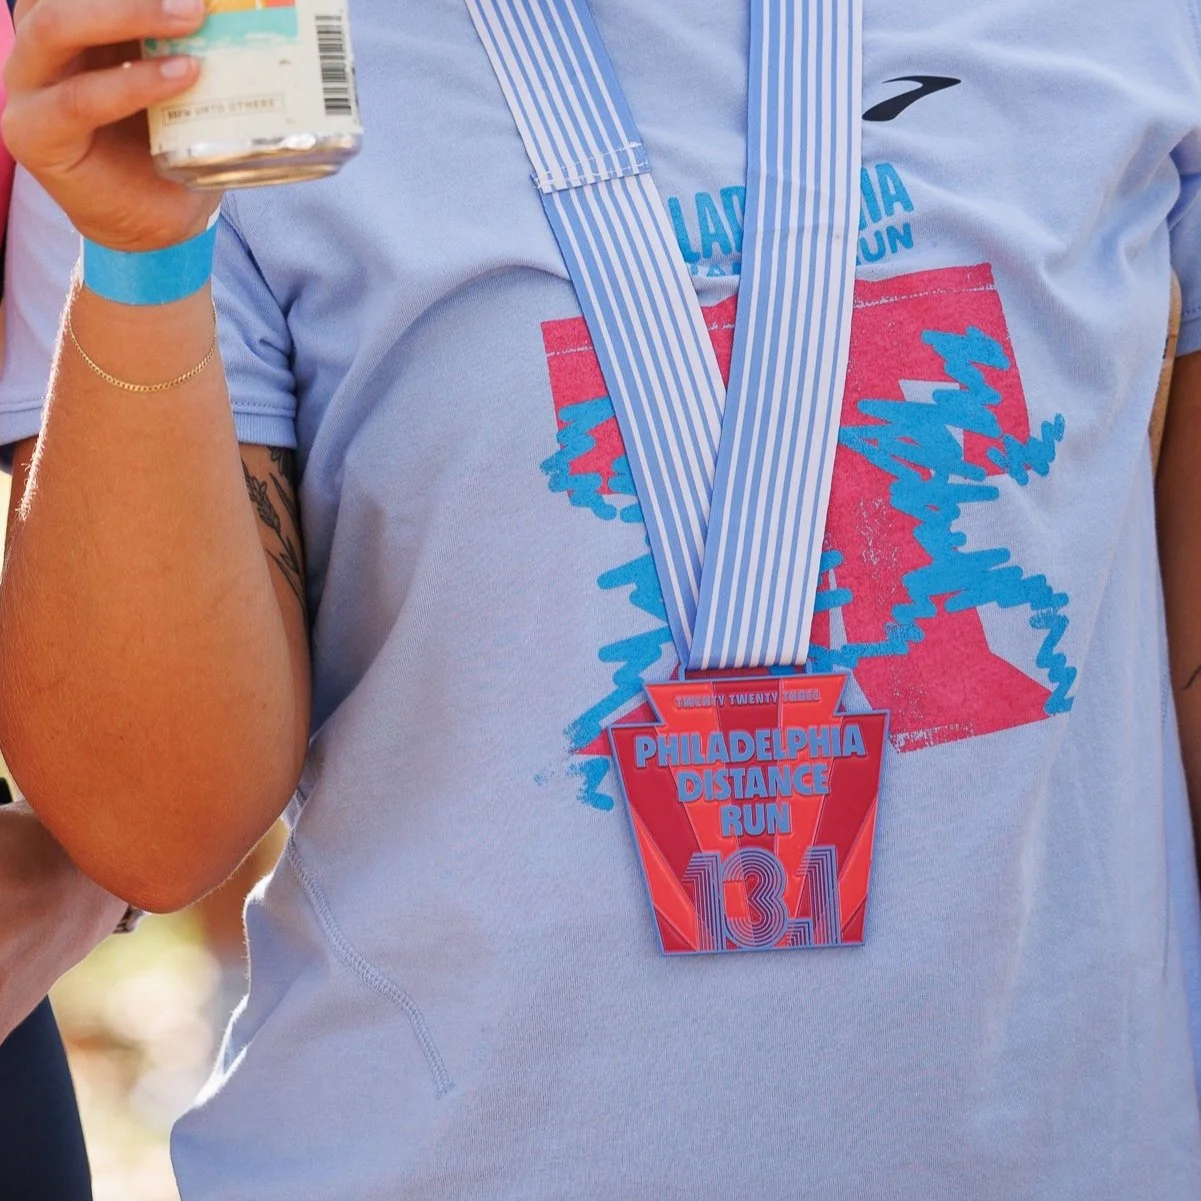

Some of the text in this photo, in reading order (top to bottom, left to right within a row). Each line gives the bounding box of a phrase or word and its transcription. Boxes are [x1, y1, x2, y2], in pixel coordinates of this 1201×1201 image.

[675, 695, 725, 708] TWENTY
[729, 691, 778, 705] TWENTY
[635, 724, 867, 769] PHILADELPHIA
[677, 764, 831, 802] DISTANCE
[721, 803, 792, 837] RUN
[682, 845, 843, 952] 13.1
